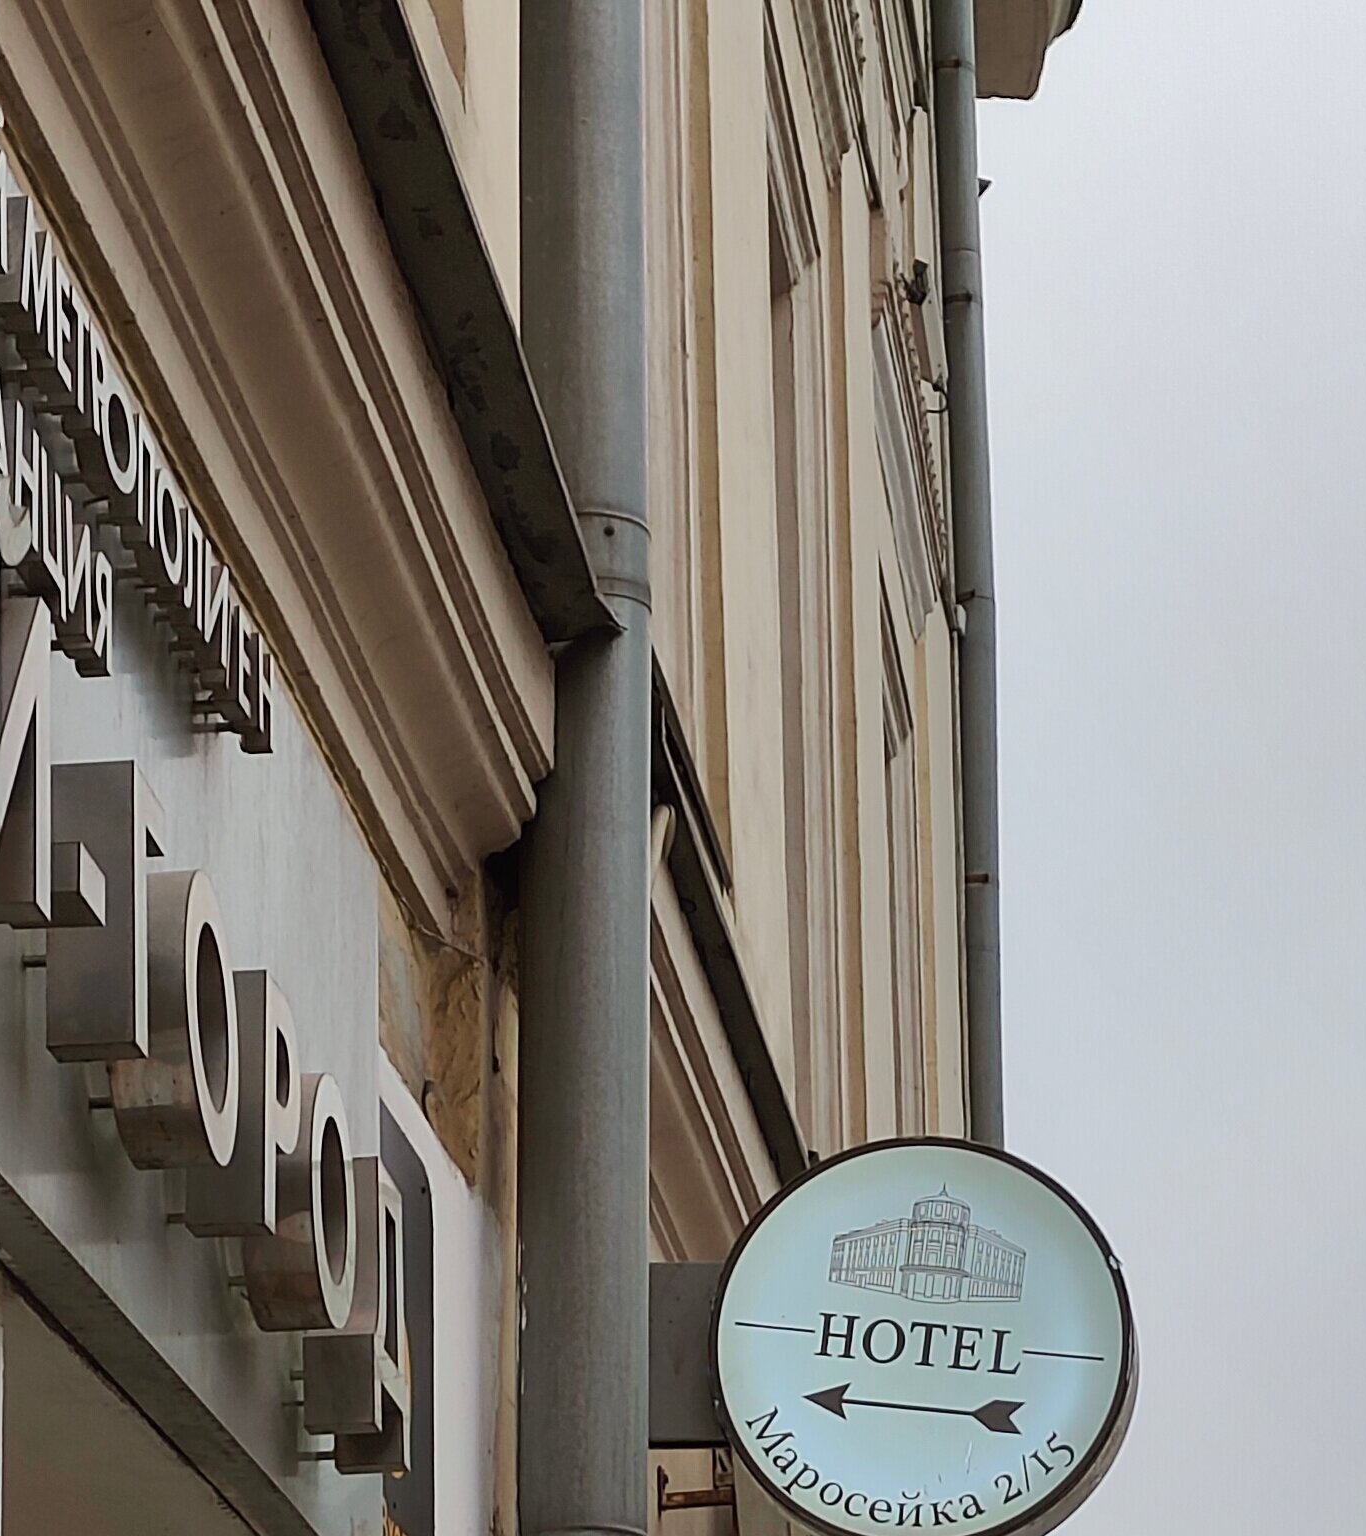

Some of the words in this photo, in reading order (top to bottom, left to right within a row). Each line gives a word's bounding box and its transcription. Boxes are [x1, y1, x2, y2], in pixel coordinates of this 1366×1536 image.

[813, 1312, 1022, 1376] HOTEL
[745, 1405, 986, 1529] Маросейка
[994, 1430, 1080, 1506] 2/15
